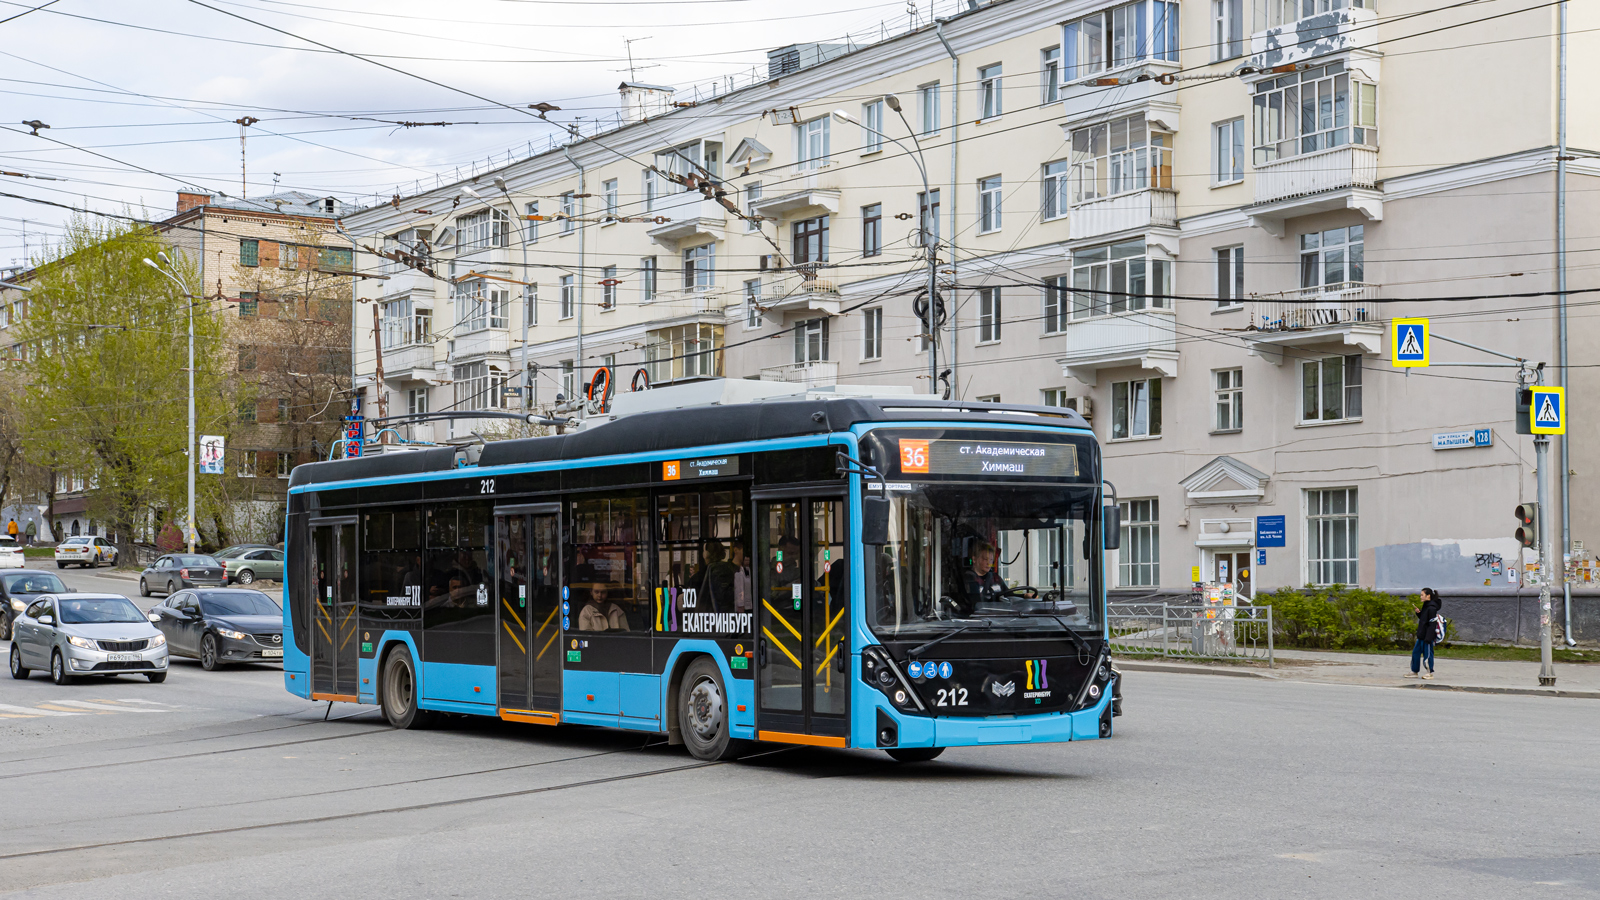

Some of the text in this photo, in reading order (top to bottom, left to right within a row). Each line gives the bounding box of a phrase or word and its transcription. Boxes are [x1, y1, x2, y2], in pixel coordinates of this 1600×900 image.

[347, 421, 361, 459] ПРАЧ
[1437, 438, 1470, 446] МАЛЫШЕВА
[1477, 432, 1489, 443] 128
[903, 447, 925, 467] 36
[959, 445, 1045, 457] ст. Академическая
[667, 465, 677, 476] 36
[981, 461, 1024, 473] Химмаш
[480, 479, 495, 494] 212
[682, 612, 753, 634] ЕКАТЕРИНБУРГ
[936, 688, 969, 707] 212
[1024, 690, 1052, 698] ЕКАТЕРИНБУРГ
